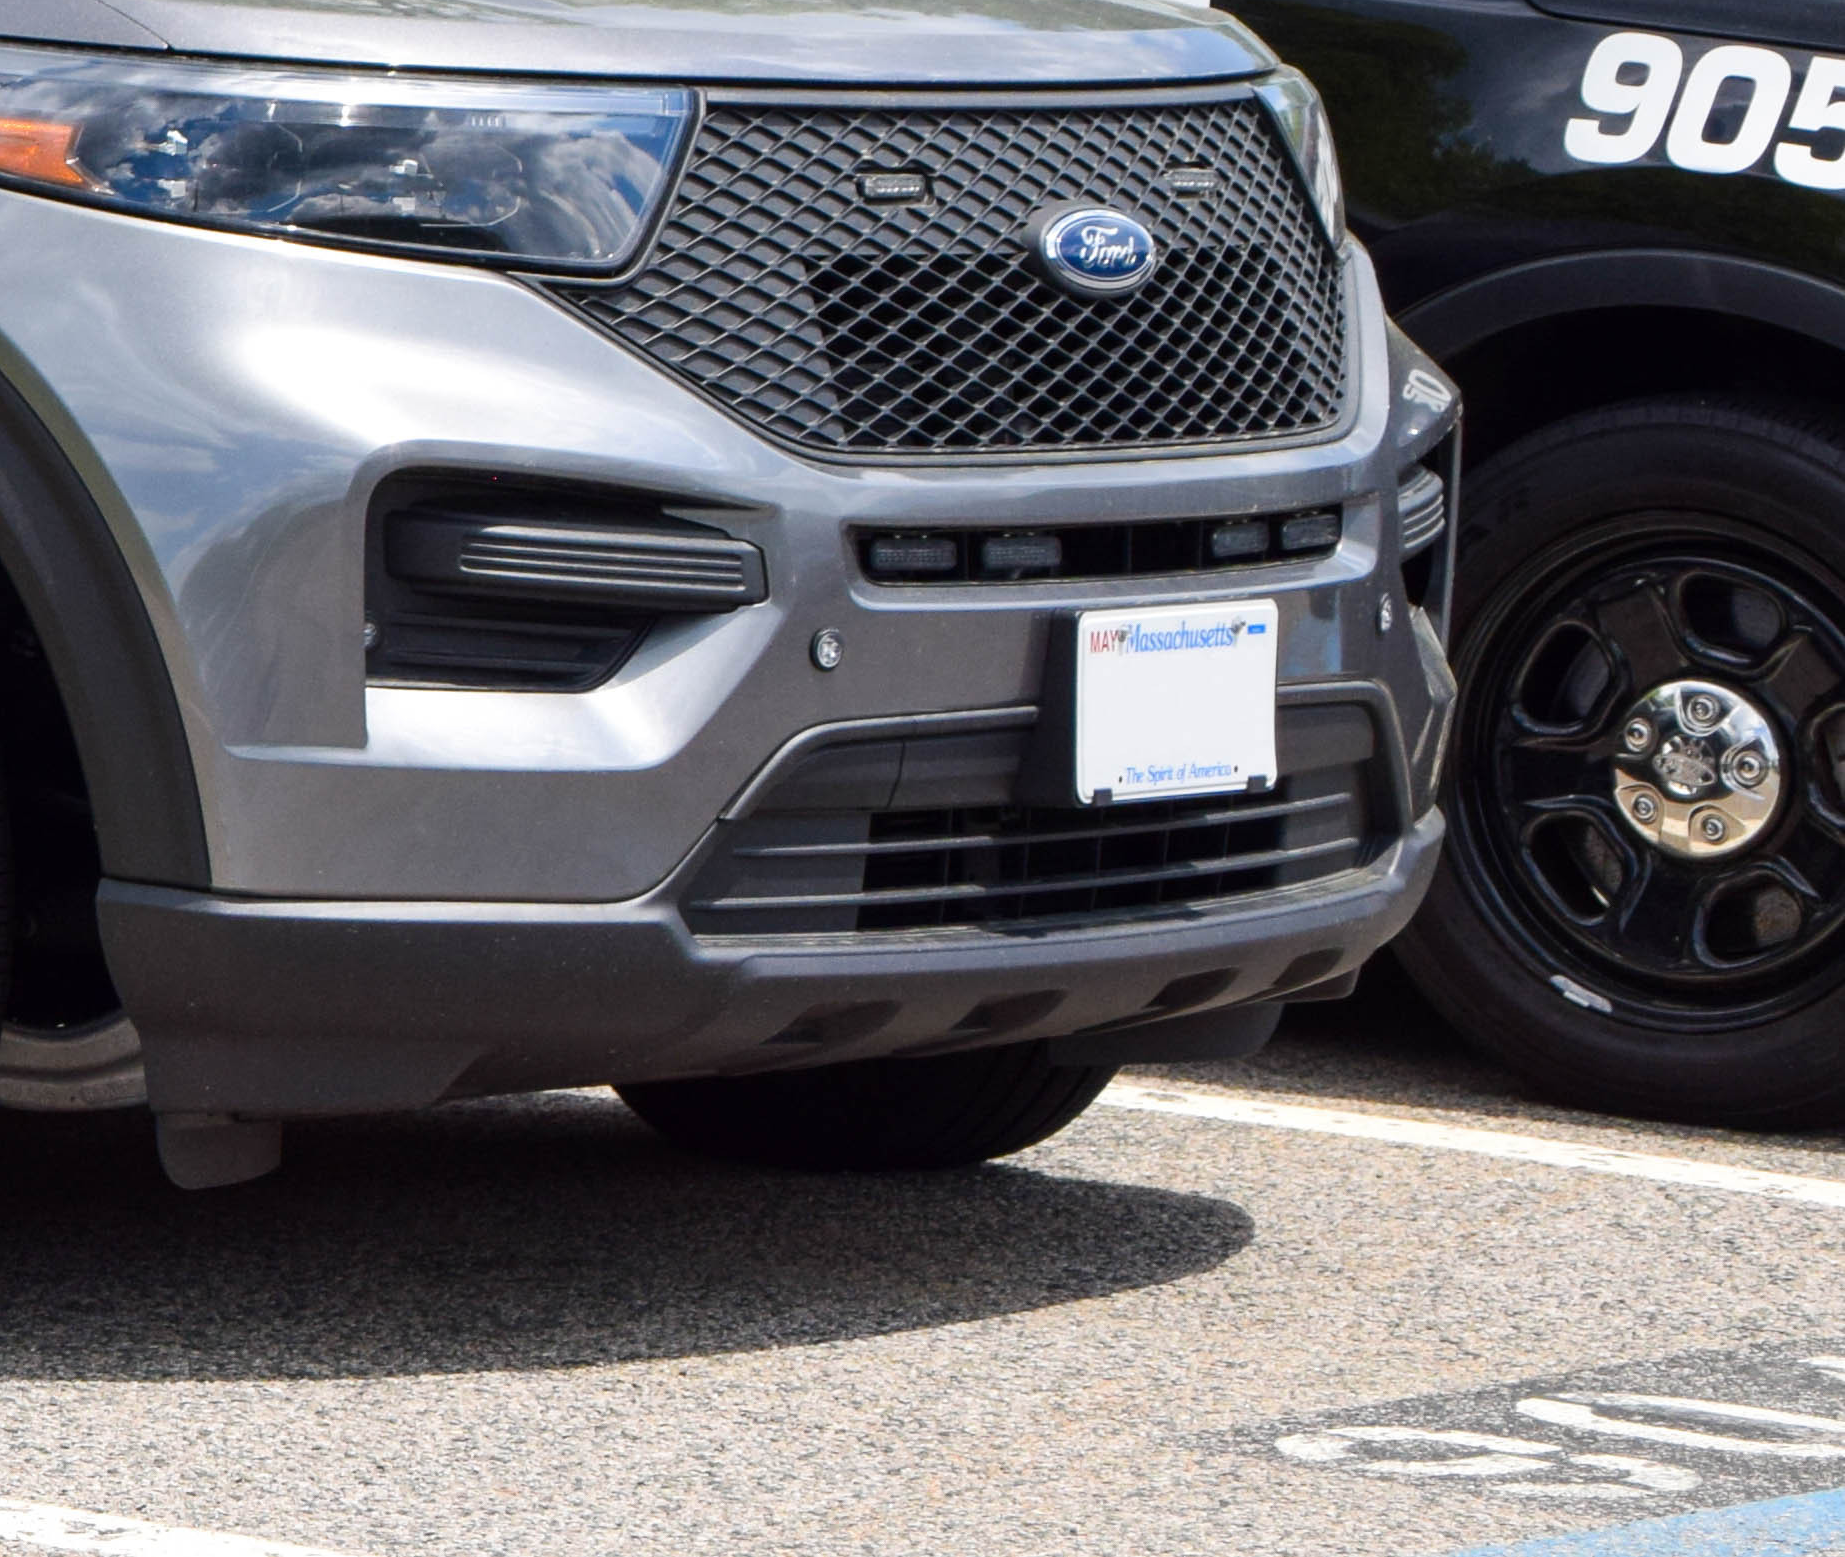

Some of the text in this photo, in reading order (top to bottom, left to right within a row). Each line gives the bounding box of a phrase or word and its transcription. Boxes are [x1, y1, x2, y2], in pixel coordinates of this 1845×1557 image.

[1564, 31, 1845, 190] 905
[1080, 225, 1137, 268] Ford
[1090, 620, 1234, 654] MAY Massachusetts
[1126, 761, 1232, 786] The Spirit of America
